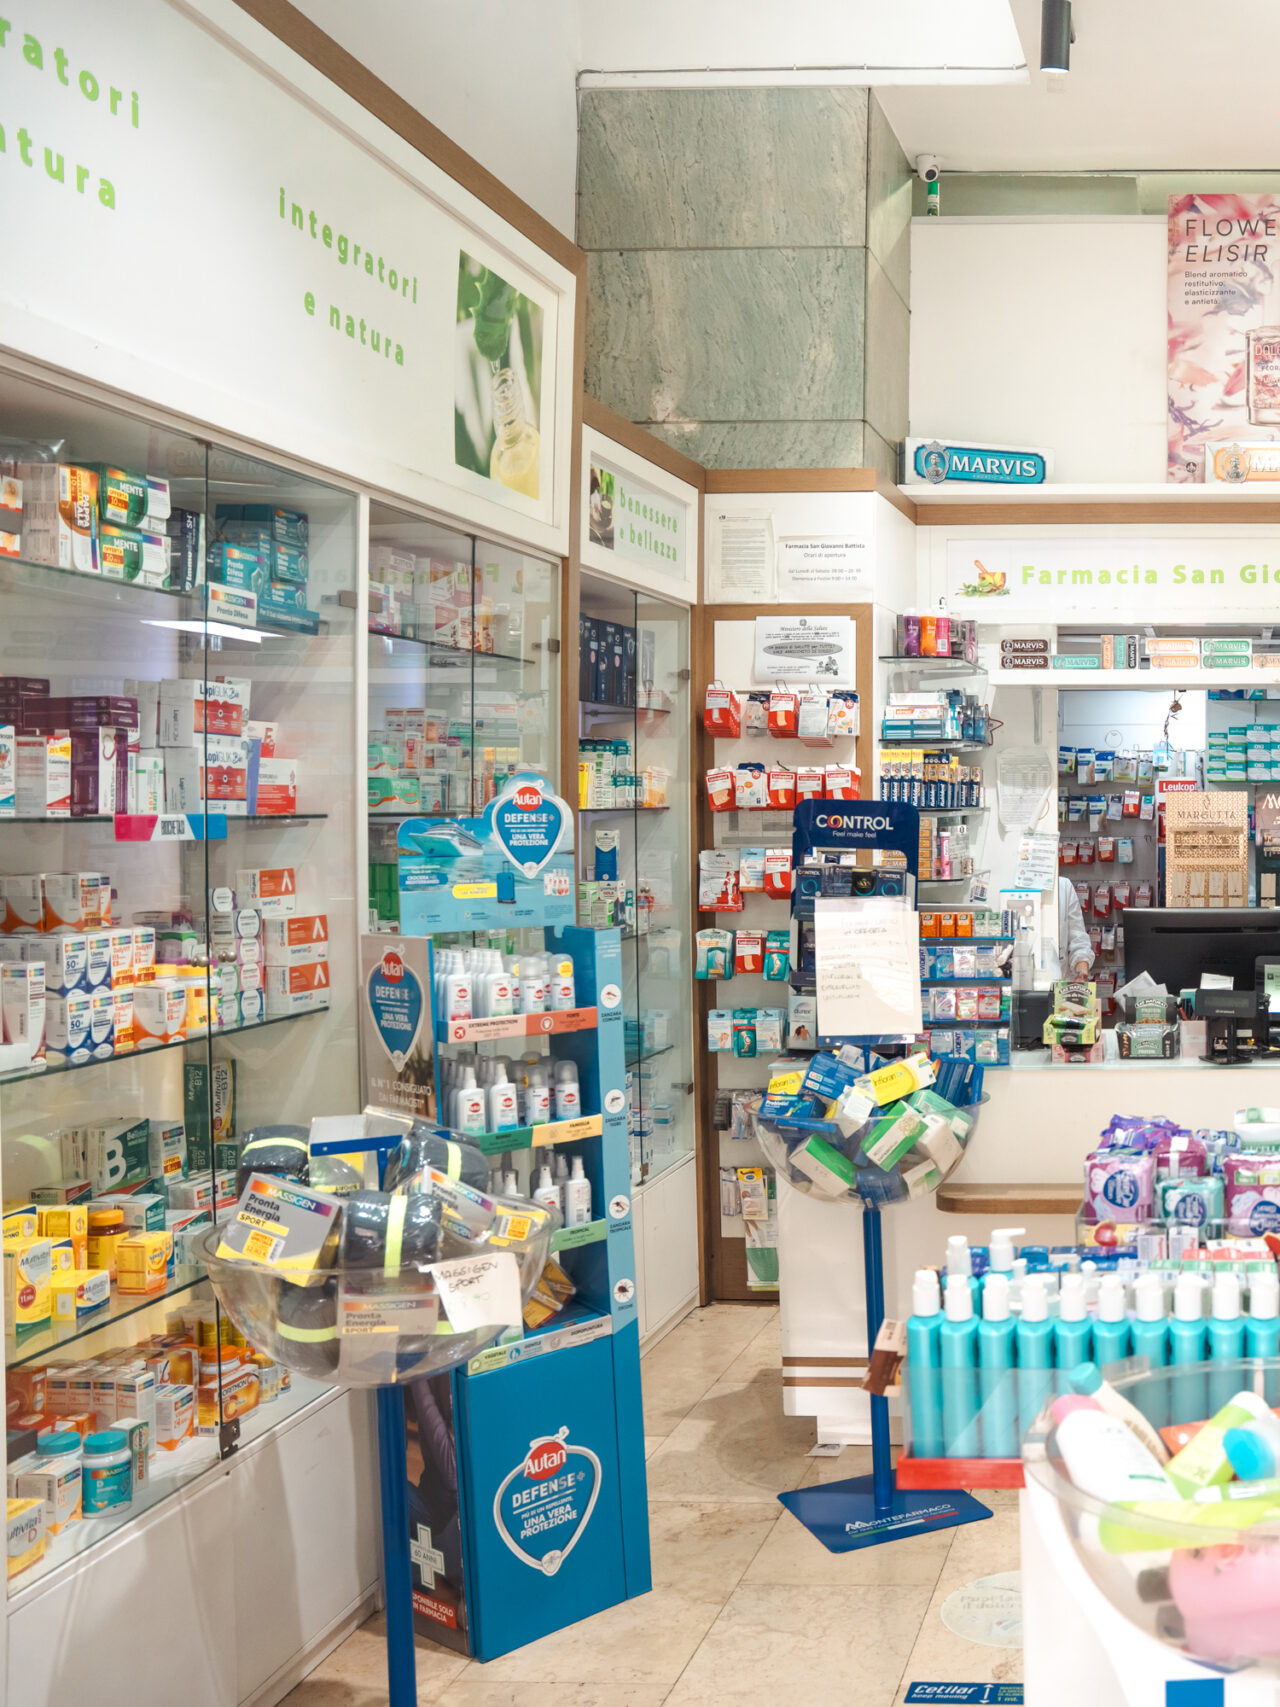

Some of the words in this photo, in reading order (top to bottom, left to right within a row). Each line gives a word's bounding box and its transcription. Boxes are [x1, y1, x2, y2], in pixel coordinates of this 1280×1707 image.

[279, 187, 418, 304] integratori
[1185, 244, 1269, 262] ELISIR
[304, 289, 316, 315] e
[329, 307, 405, 366] natura
[952, 455, 1037, 477] MARVIS
[120, 482, 144, 497] MENTE
[620, 487, 678, 533] benessere
[114, 538, 138, 552] MENTE
[619, 529, 625, 539] e
[629, 523, 678, 562] bellezza
[1021, 565, 1158, 585] Farmacia
[1173, 564, 1225, 584] San
[513, 794, 543, 805] Autan
[816, 814, 894, 831] CONTROL
[380, 961, 404, 977] Autan
[248, 1193, 280, 1212] Pronta
[267, 1187, 316, 1210] MASSIGEN
[239, 1214, 266, 1227] SPORT
[245, 1203, 281, 1222] Energia
[523, 1449, 567, 1477] Autan
[520, 1510, 578, 1539] PROTEZIONE
[524, 1515, 546, 1529] UNA
[548, 1504, 572, 1520] VERA
[845, 1503, 951, 1532] MONTEFARMACO
[420, 1607, 447, 1622] FARMACIA
[439, 1604, 454, 1617] SOLO
[914, 1684, 978, 1695] Cetilar
[934, 1693, 969, 1701] moving
